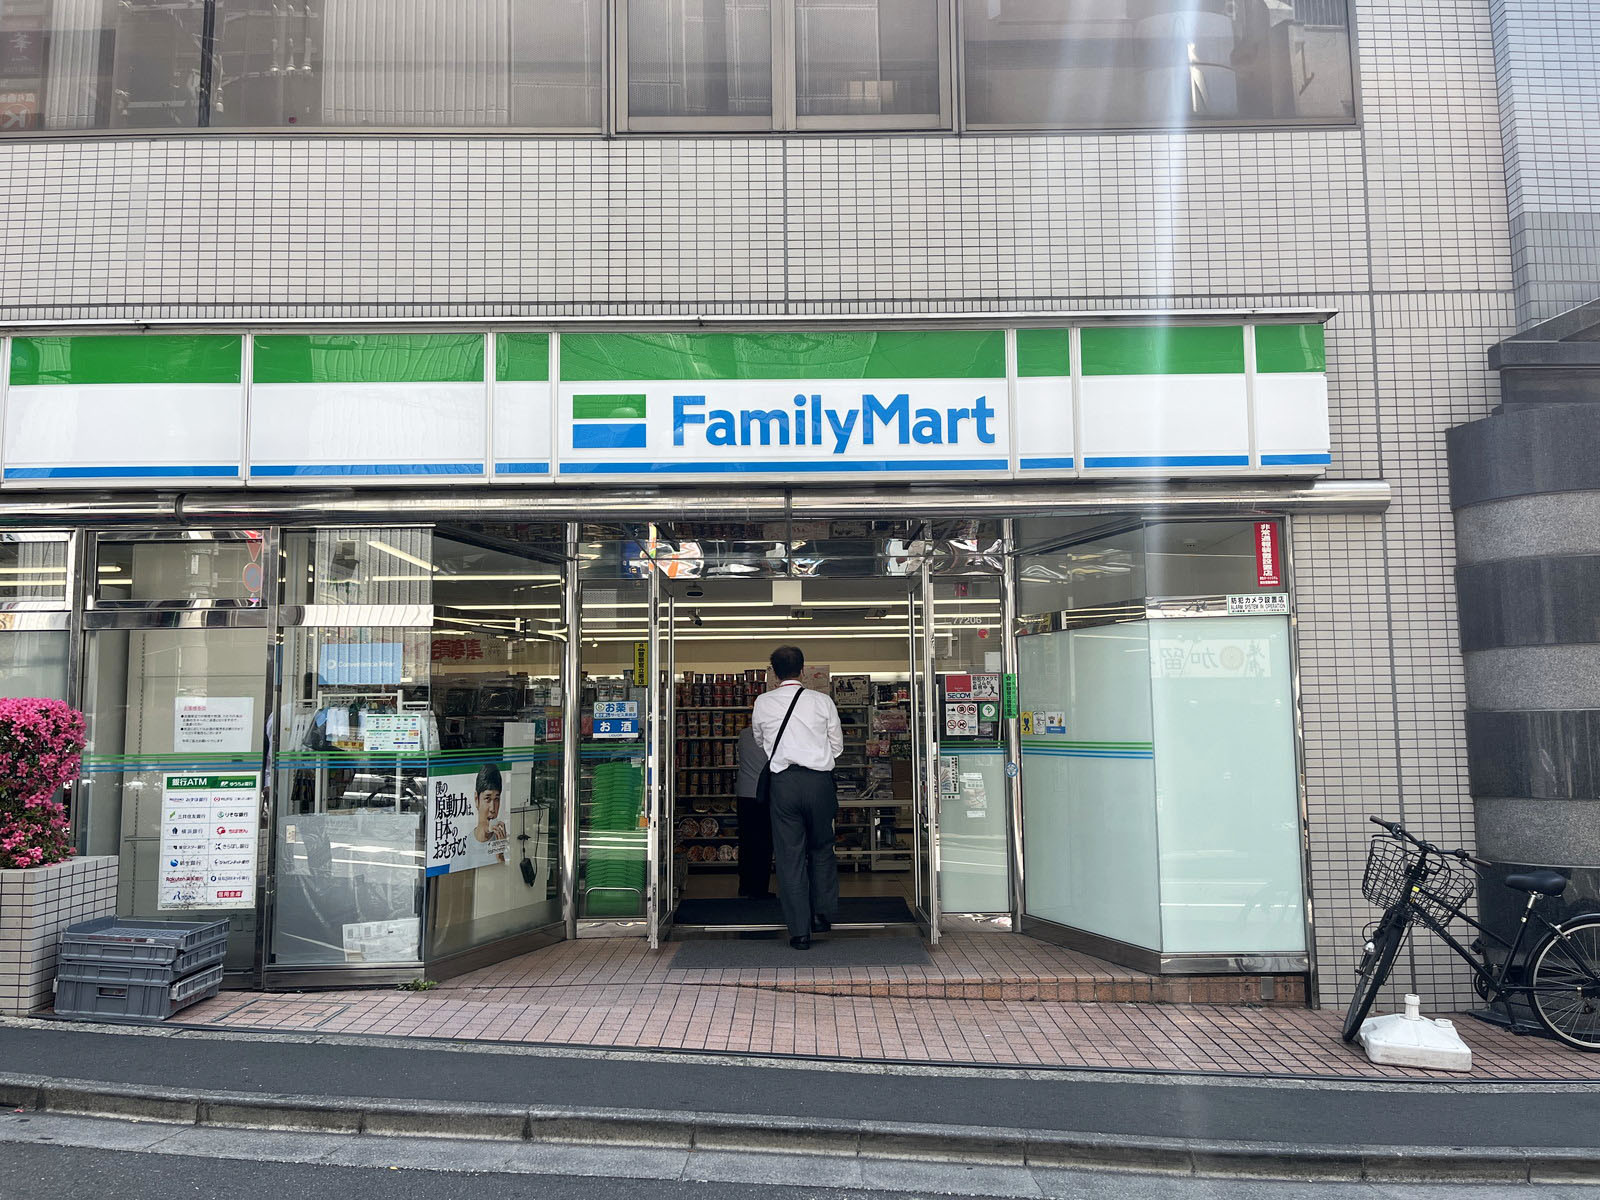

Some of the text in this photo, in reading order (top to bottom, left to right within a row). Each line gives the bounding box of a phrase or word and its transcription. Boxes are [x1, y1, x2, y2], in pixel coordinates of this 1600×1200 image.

[672, 394, 996, 454] FamilyMart
[953, 617, 982, 625] 77206
[605, 703, 627, 713] お薬
[599, 721, 632, 732] お酒
[171, 777, 208, 786] 銀行ATM
[435, 780, 448, 795] 僕の
[435, 819, 459, 841] 日本の
